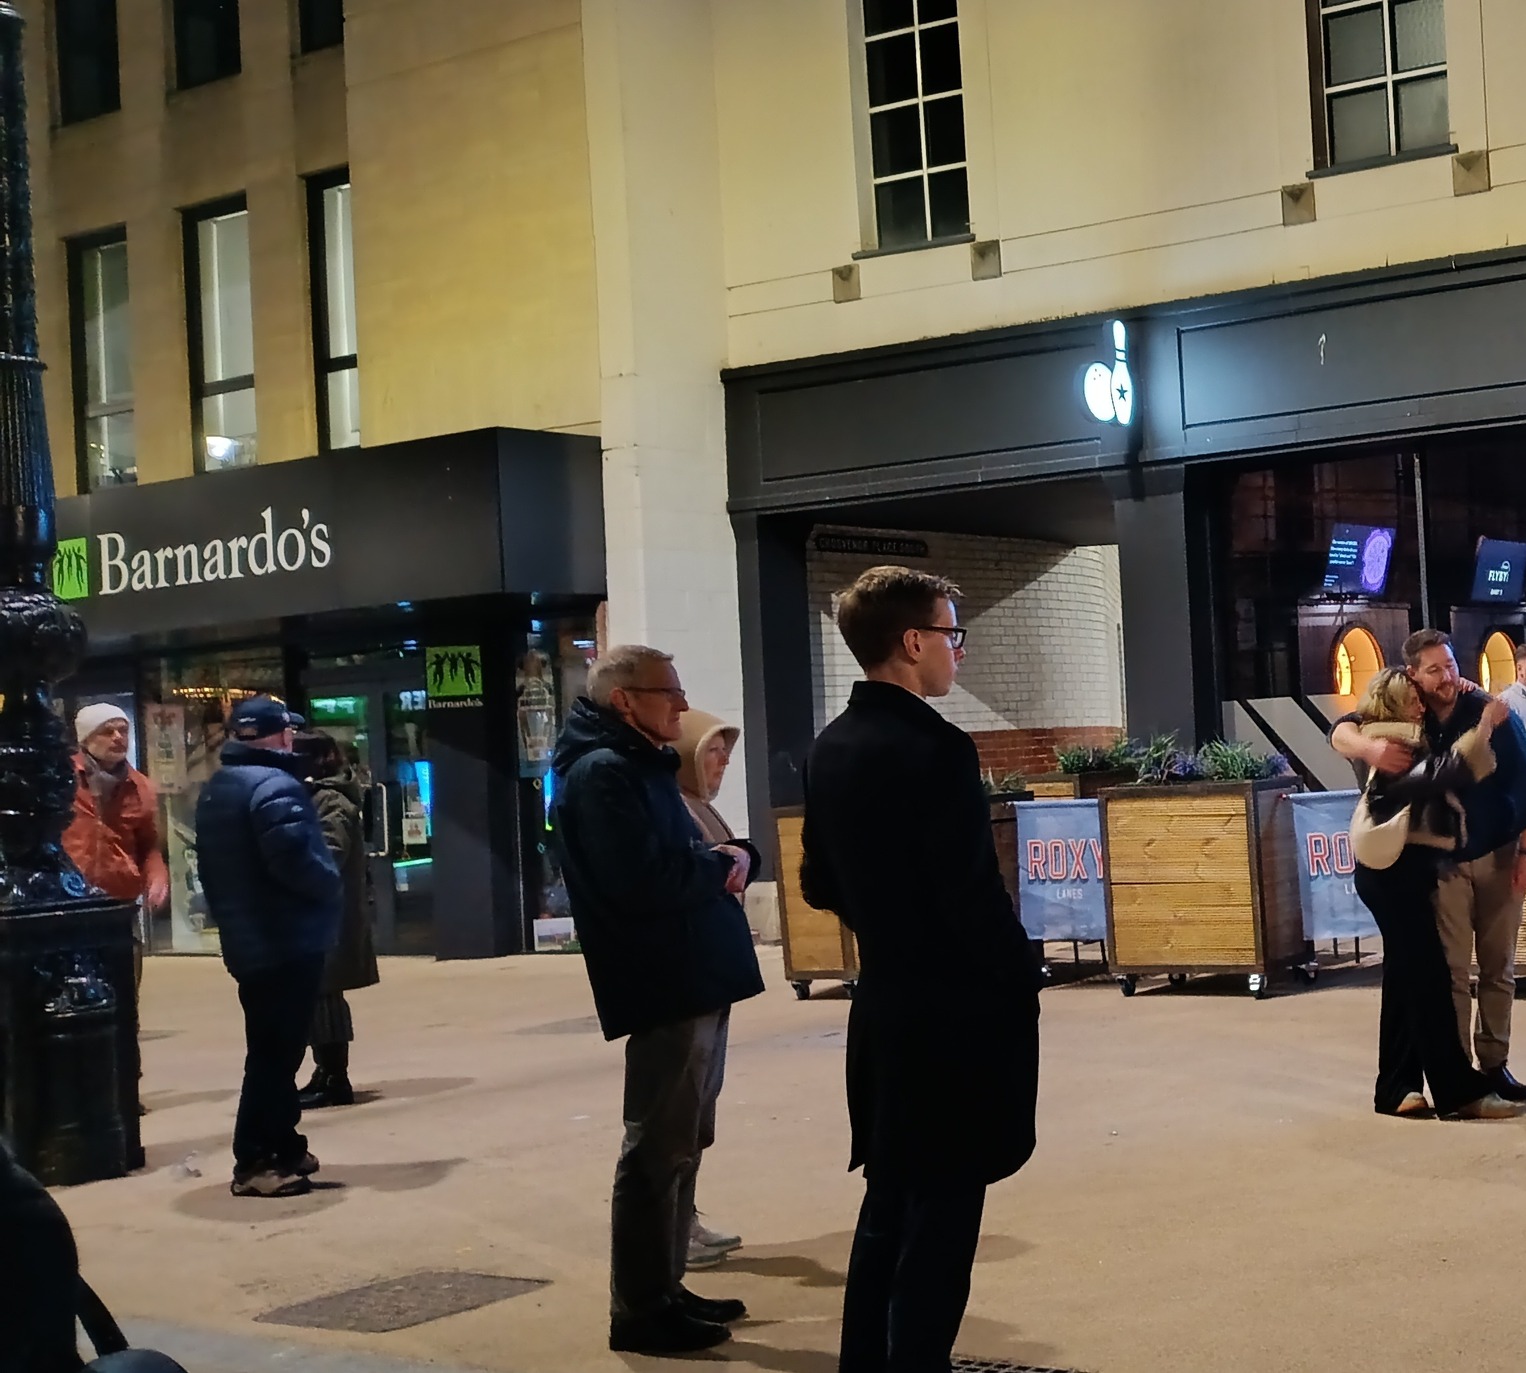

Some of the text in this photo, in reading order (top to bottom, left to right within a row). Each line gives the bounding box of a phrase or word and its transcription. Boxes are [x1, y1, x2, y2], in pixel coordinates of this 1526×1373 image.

[96, 507, 332, 596] Barnardo's
[428, 698, 484, 709] Barnardo's
[1026, 838, 1104, 882] ROXY
[1306, 831, 1356, 877] RO
[1056, 888, 1083, 900] LANES
